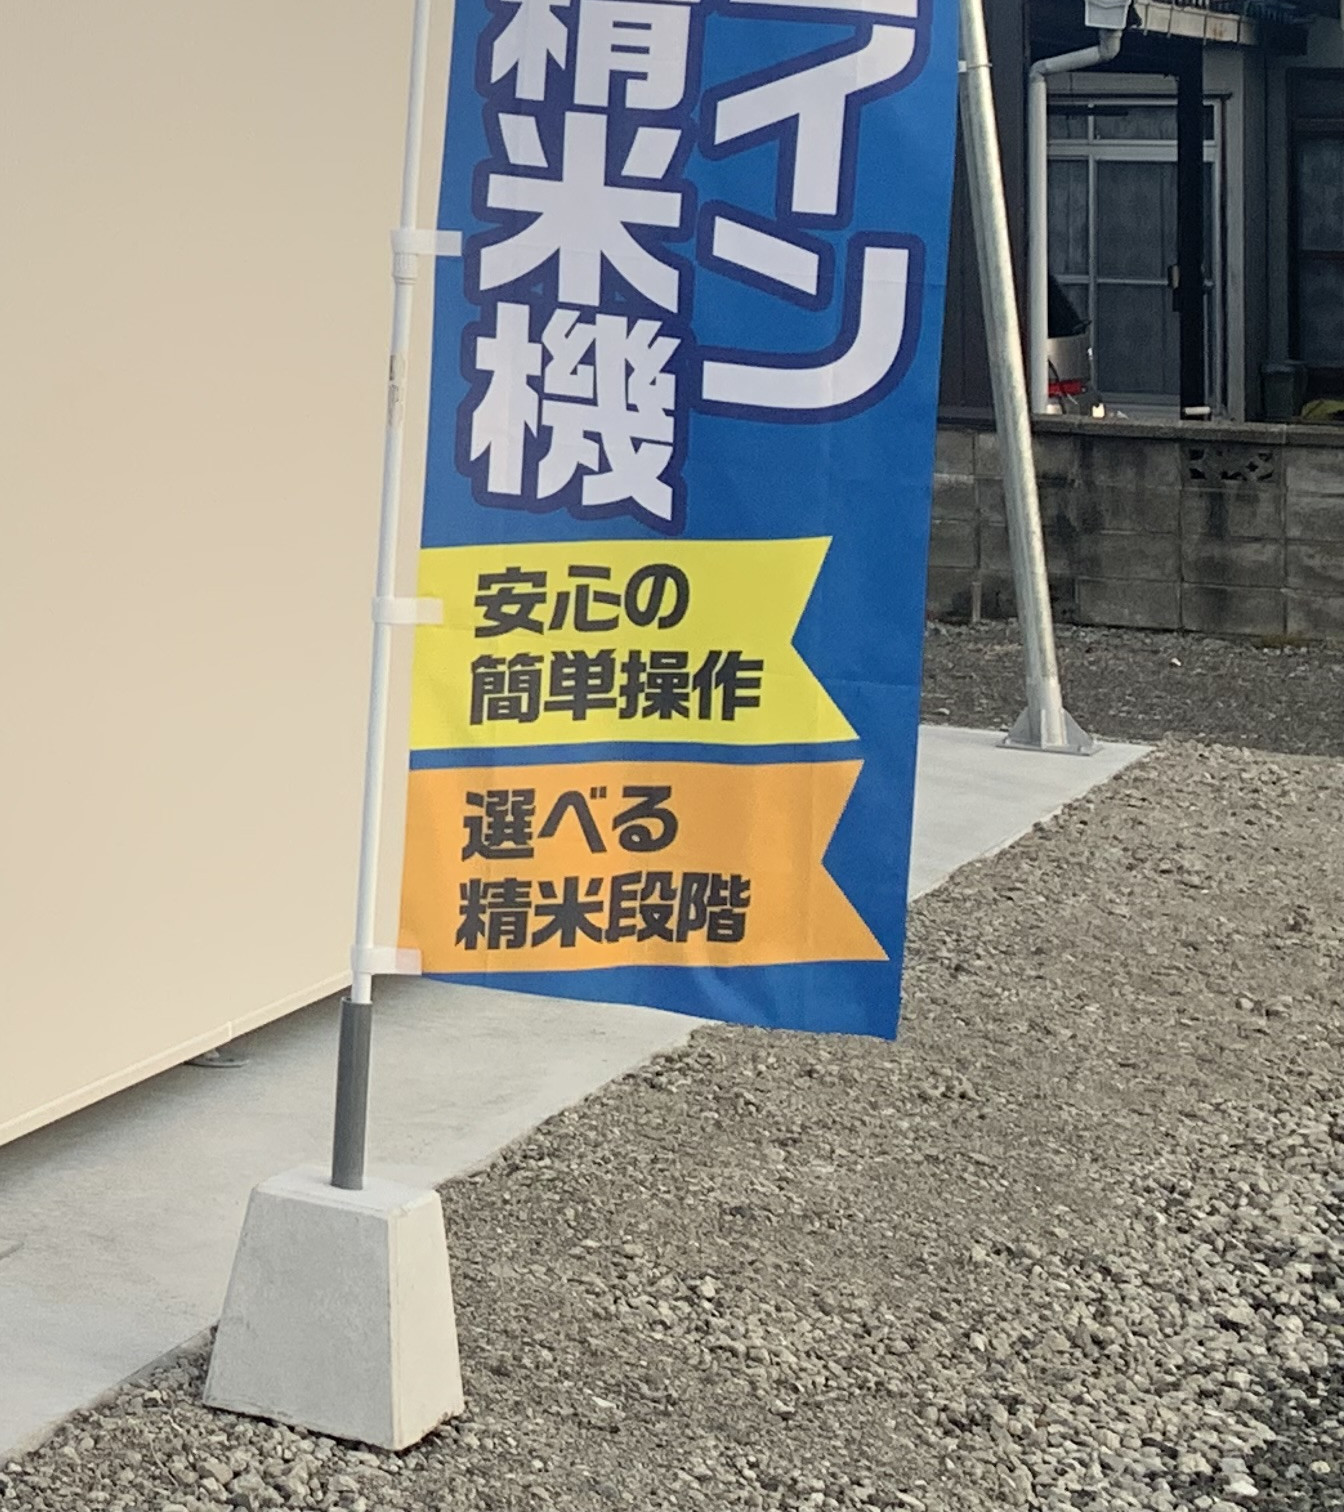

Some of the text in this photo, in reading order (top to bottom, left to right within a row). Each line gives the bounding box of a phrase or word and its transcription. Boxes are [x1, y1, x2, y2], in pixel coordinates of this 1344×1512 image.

[473, 562, 691, 639] 安心の
[468, 647, 765, 726] 簡単操作
[460, 784, 679, 863] 選べる
[454, 869, 752, 951] 精米段階
